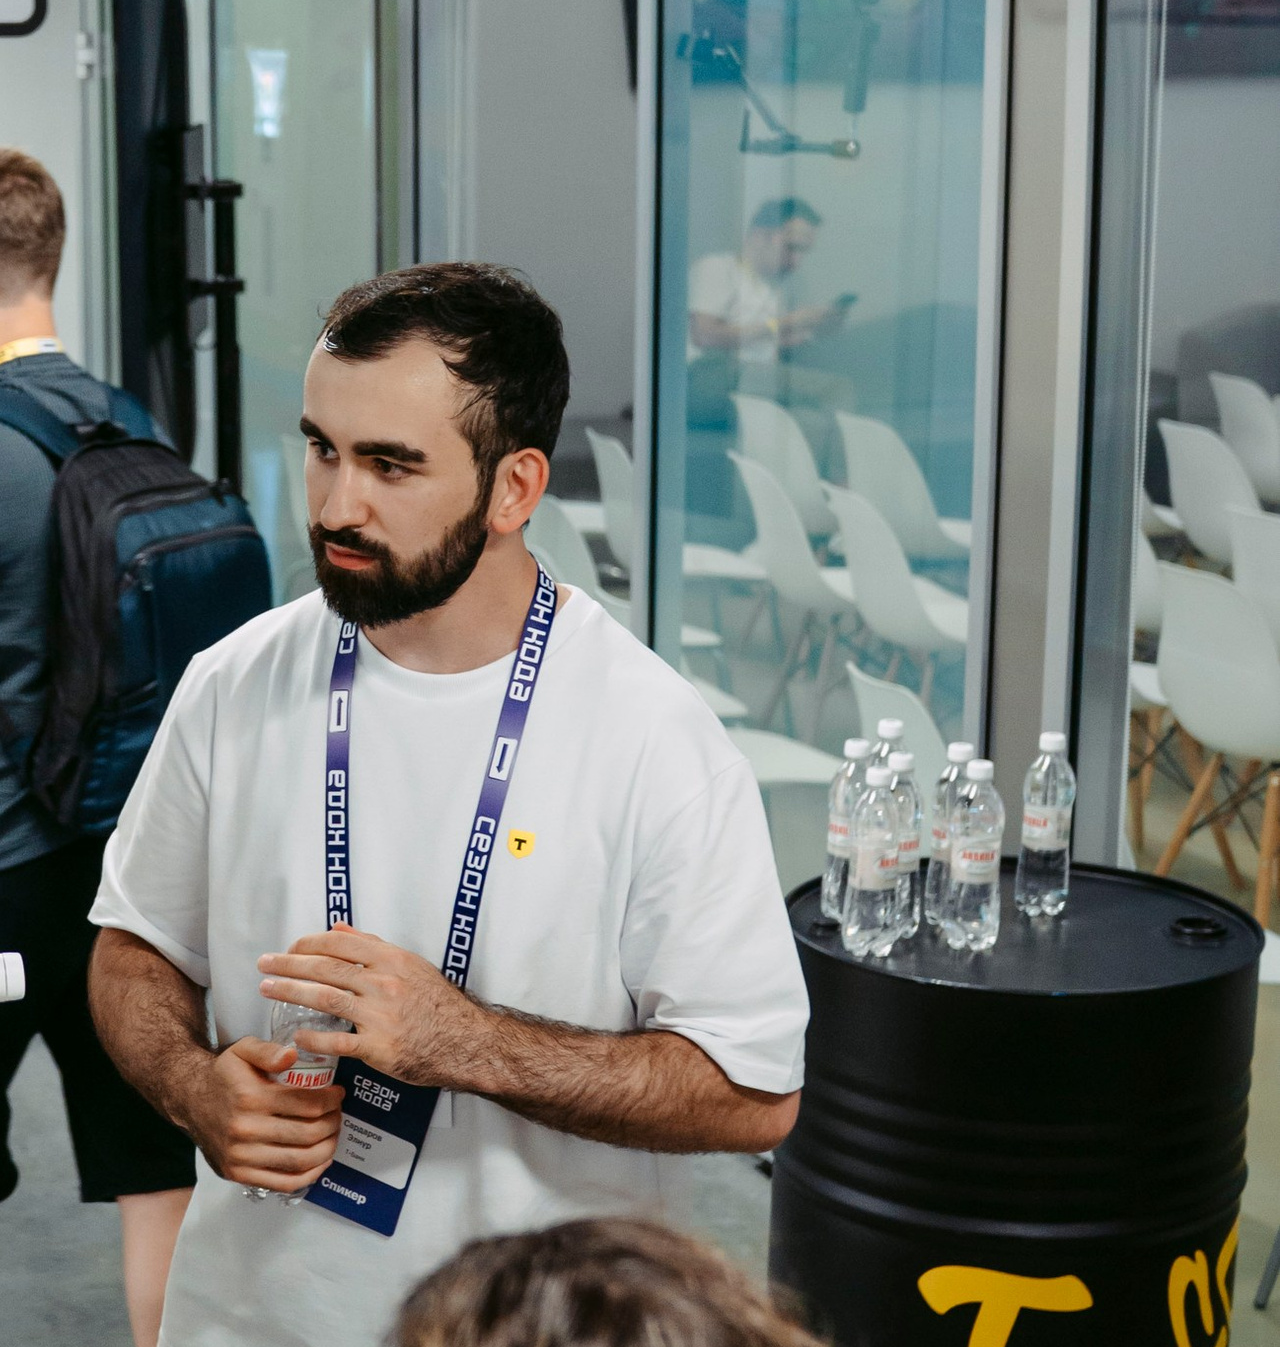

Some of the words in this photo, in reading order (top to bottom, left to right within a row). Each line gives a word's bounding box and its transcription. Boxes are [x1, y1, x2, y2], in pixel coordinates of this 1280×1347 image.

[529, 564, 556, 625] зон
[328, 852, 349, 928] езон
[321, 1177, 367, 1205] Спикер
